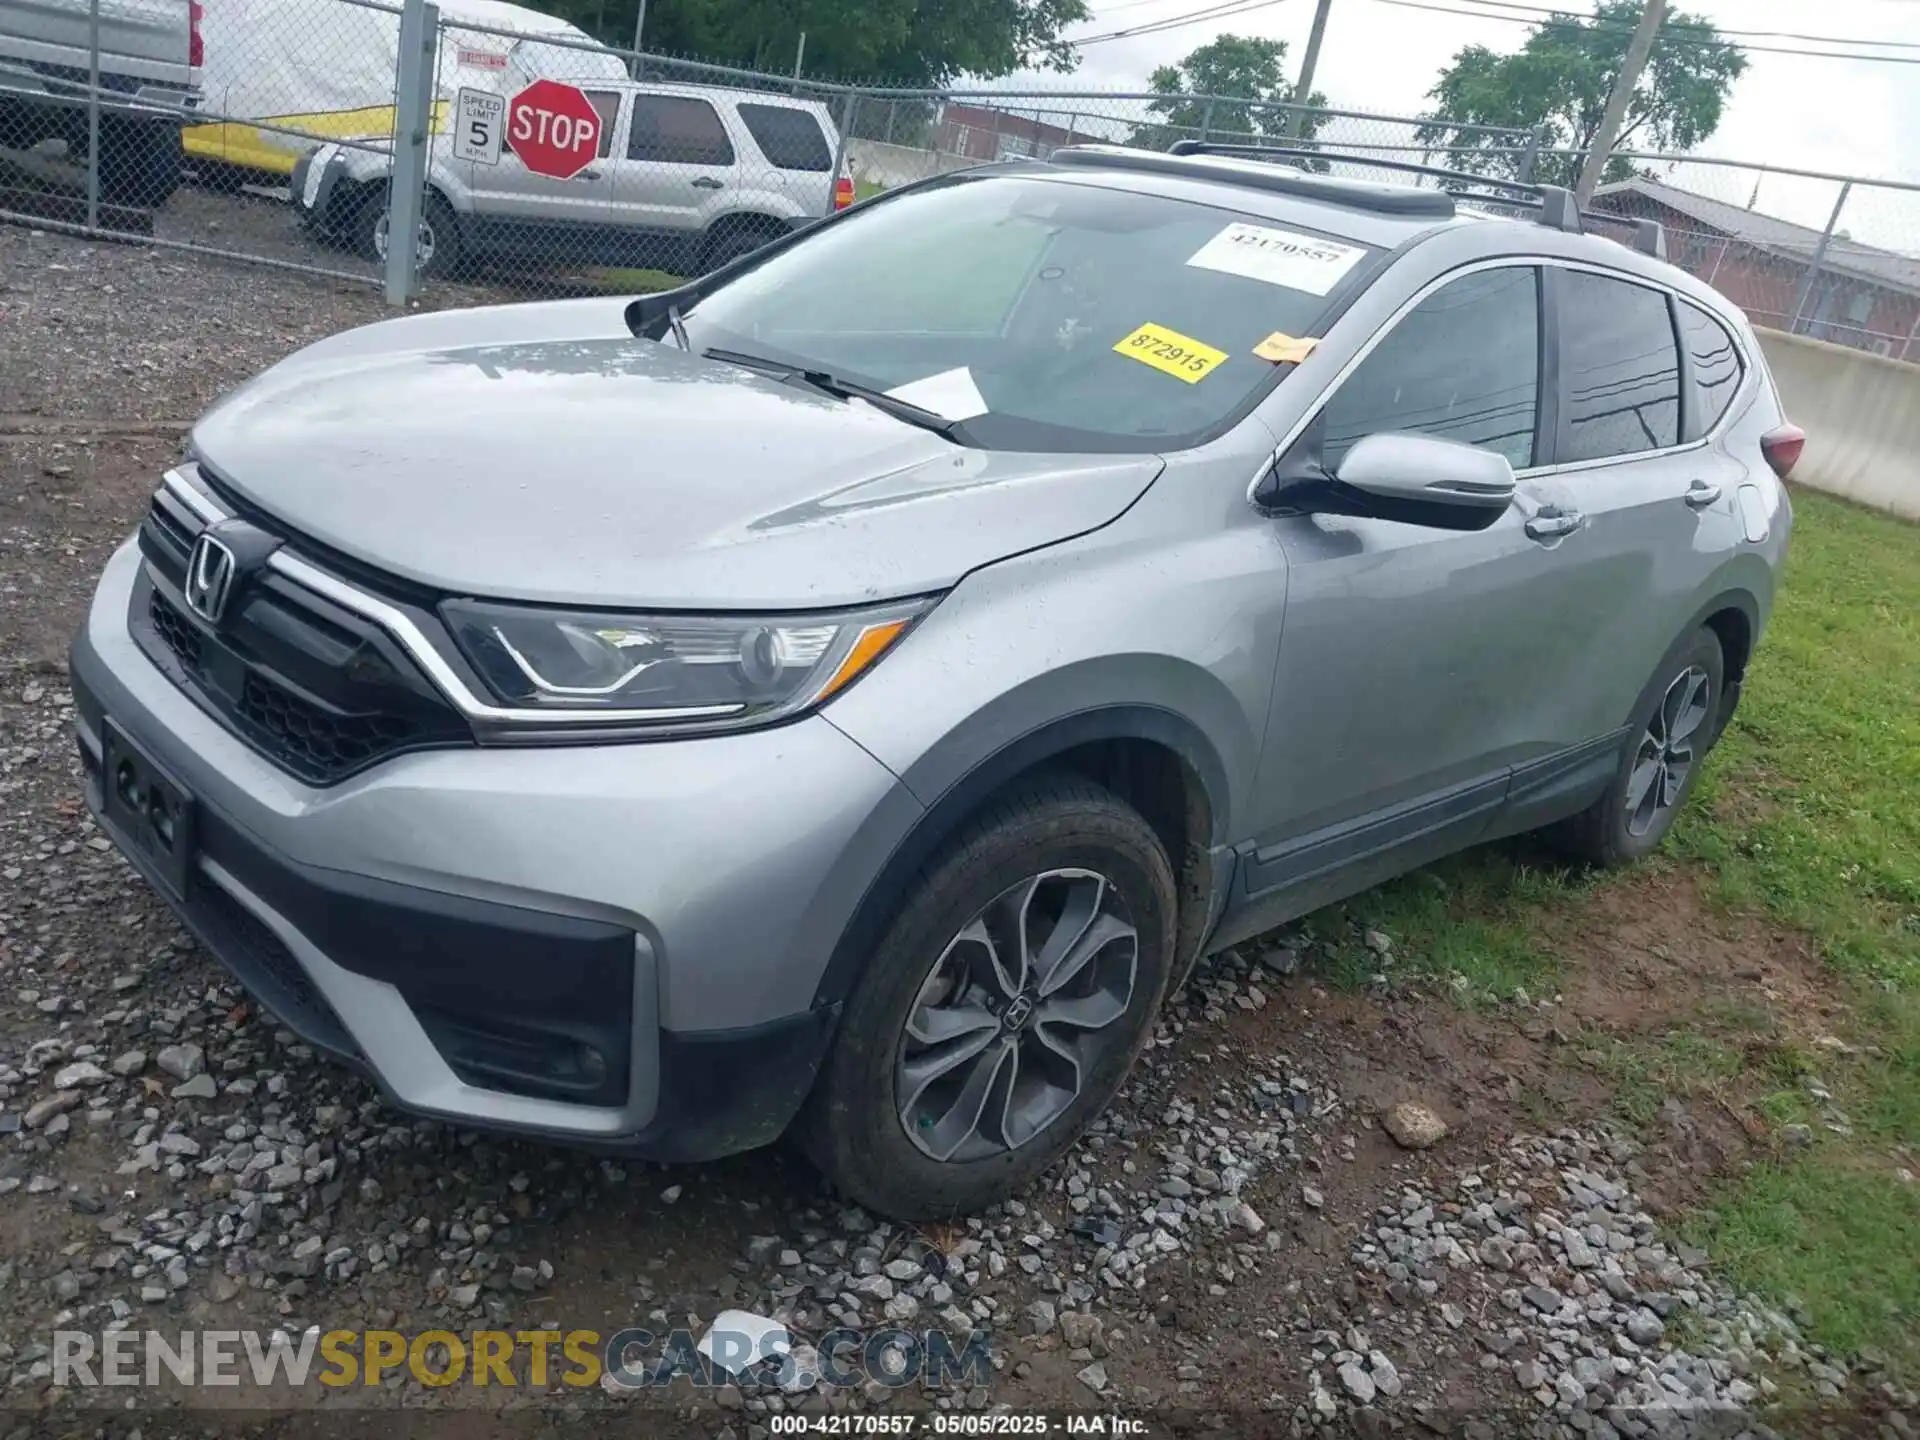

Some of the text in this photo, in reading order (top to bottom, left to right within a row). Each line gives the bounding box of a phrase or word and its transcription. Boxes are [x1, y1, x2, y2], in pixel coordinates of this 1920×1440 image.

[463, 95, 501, 112] SPEED
[466, 107, 497, 121] LIMIT
[469, 121, 489, 147] 5
[513, 105, 594, 152] STOP
[1131, 334, 1209, 372] 872915
